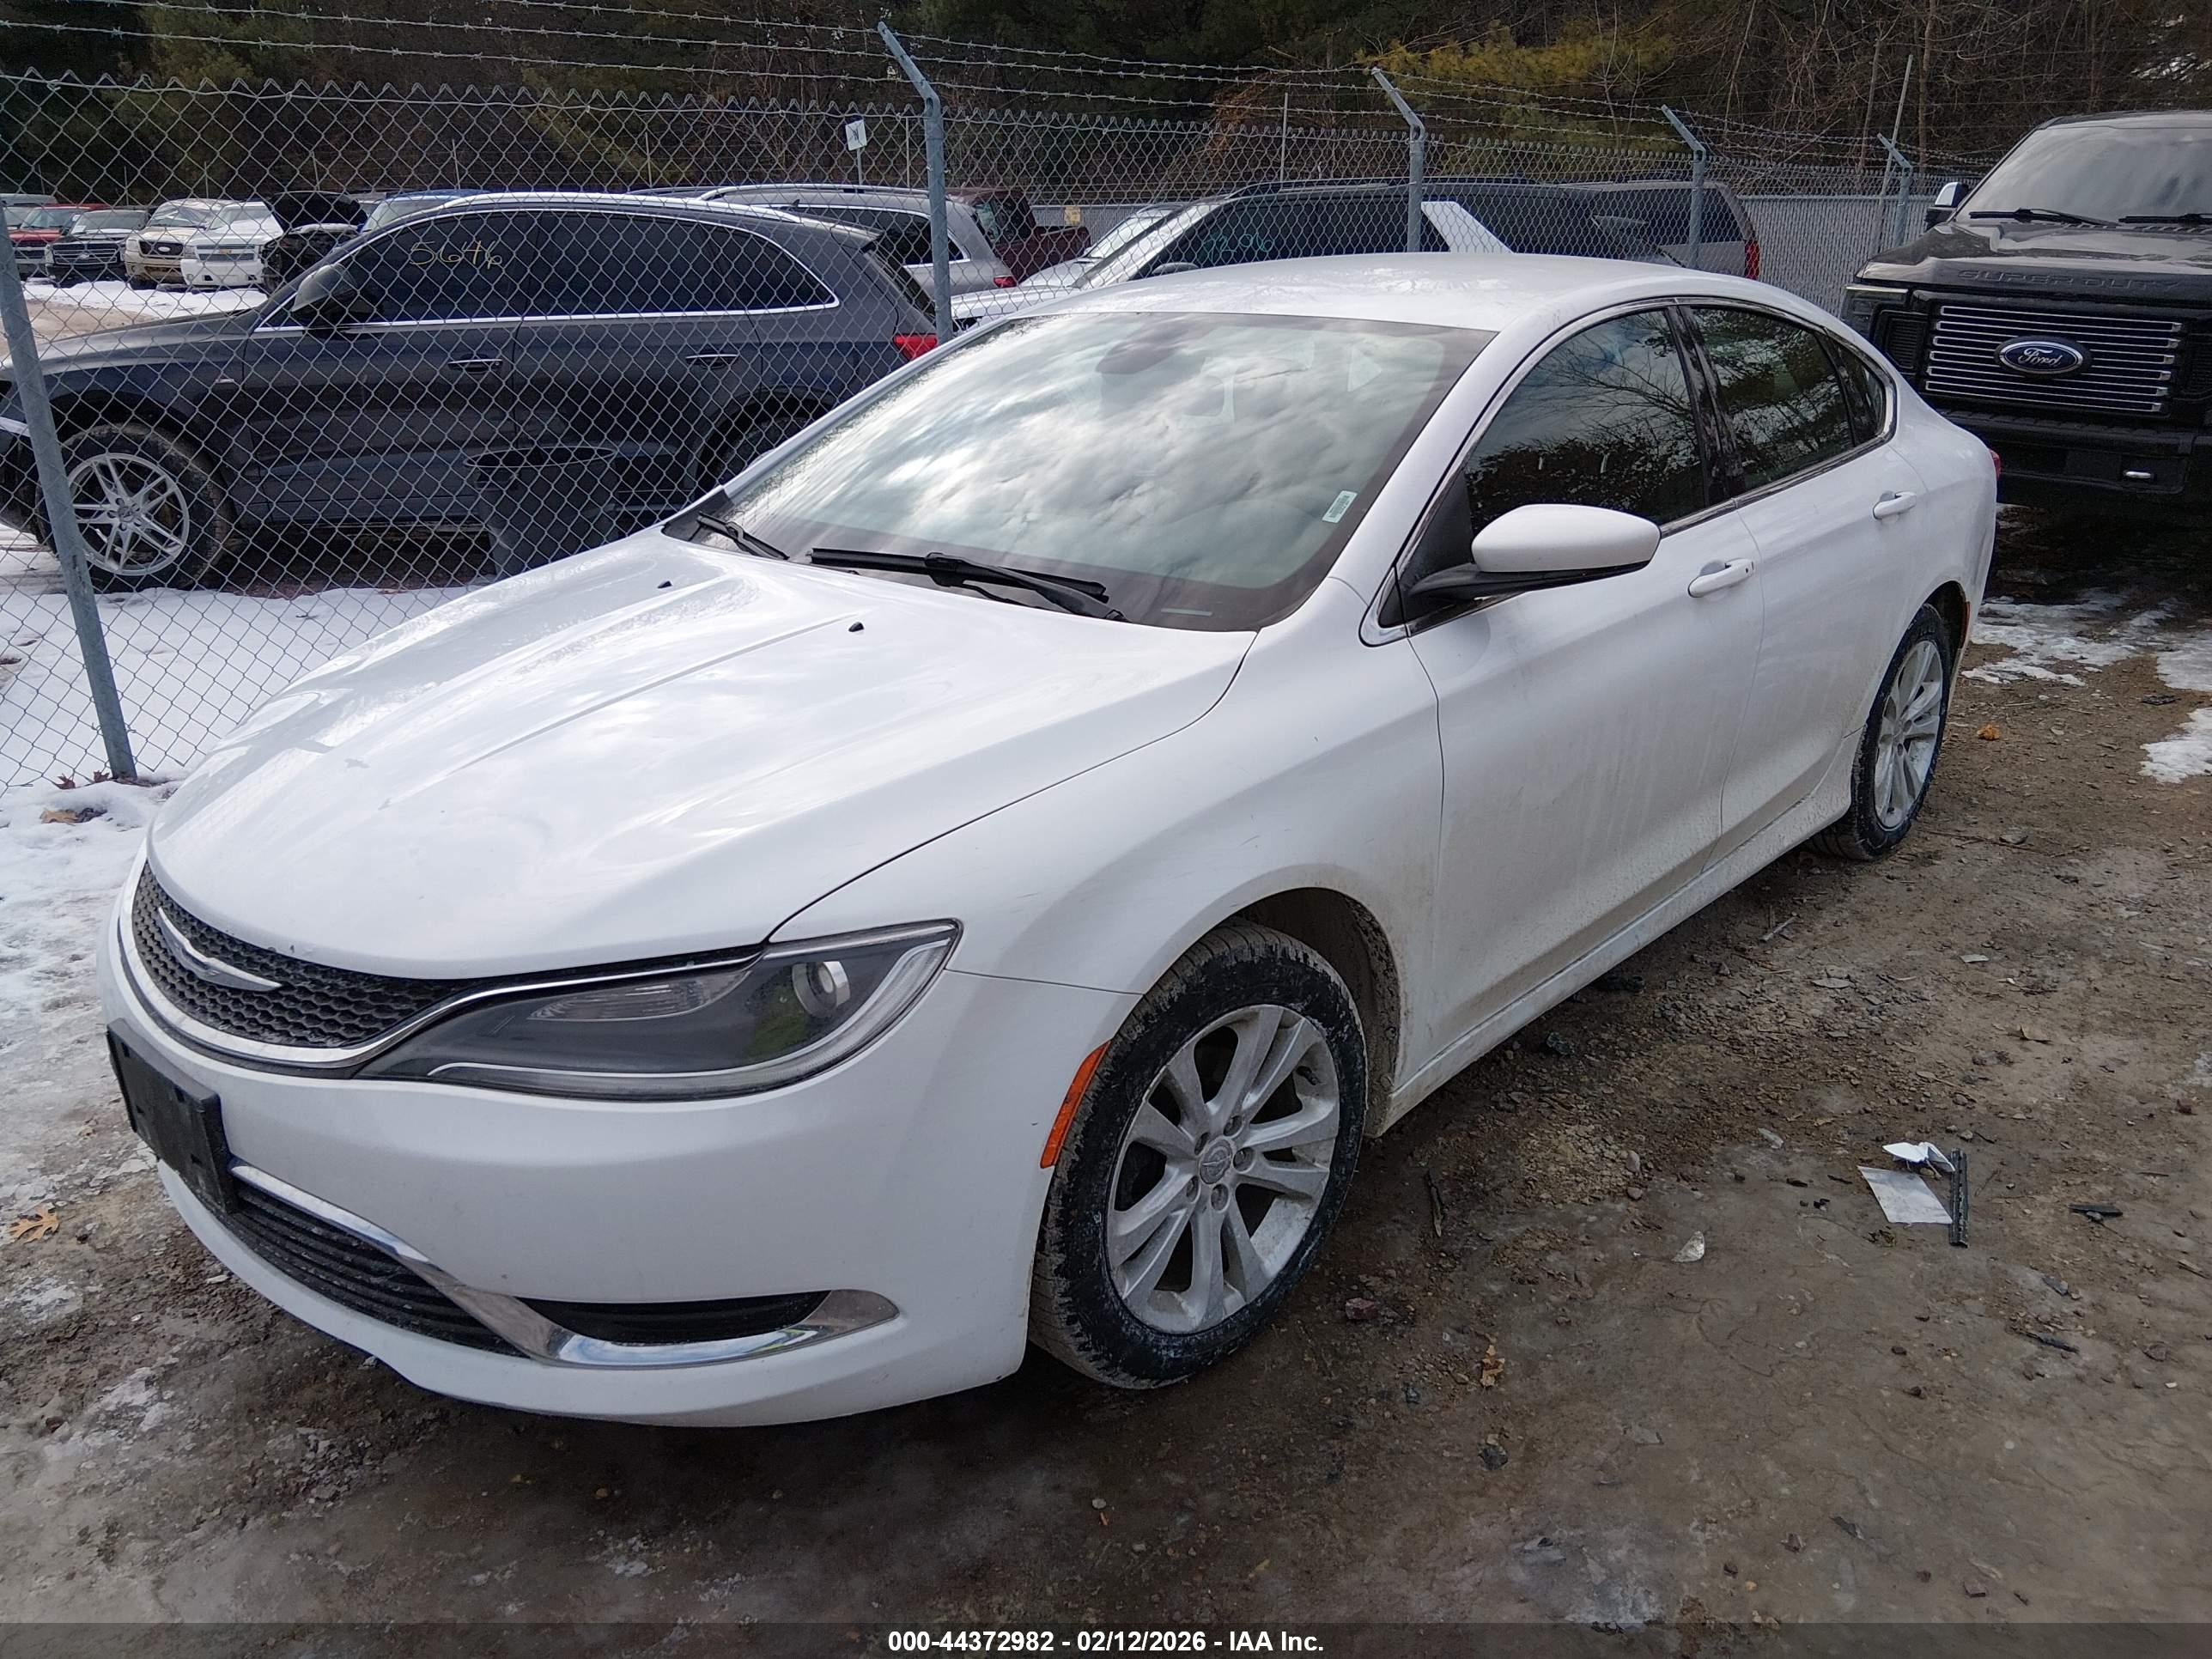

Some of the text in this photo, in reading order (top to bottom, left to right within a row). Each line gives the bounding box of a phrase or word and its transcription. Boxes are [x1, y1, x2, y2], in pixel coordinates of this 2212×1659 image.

[410, 240, 503, 270] 5646
[1957, 269, 2182, 291] SUPER DUTY
[2017, 347, 2063, 368] Ford
